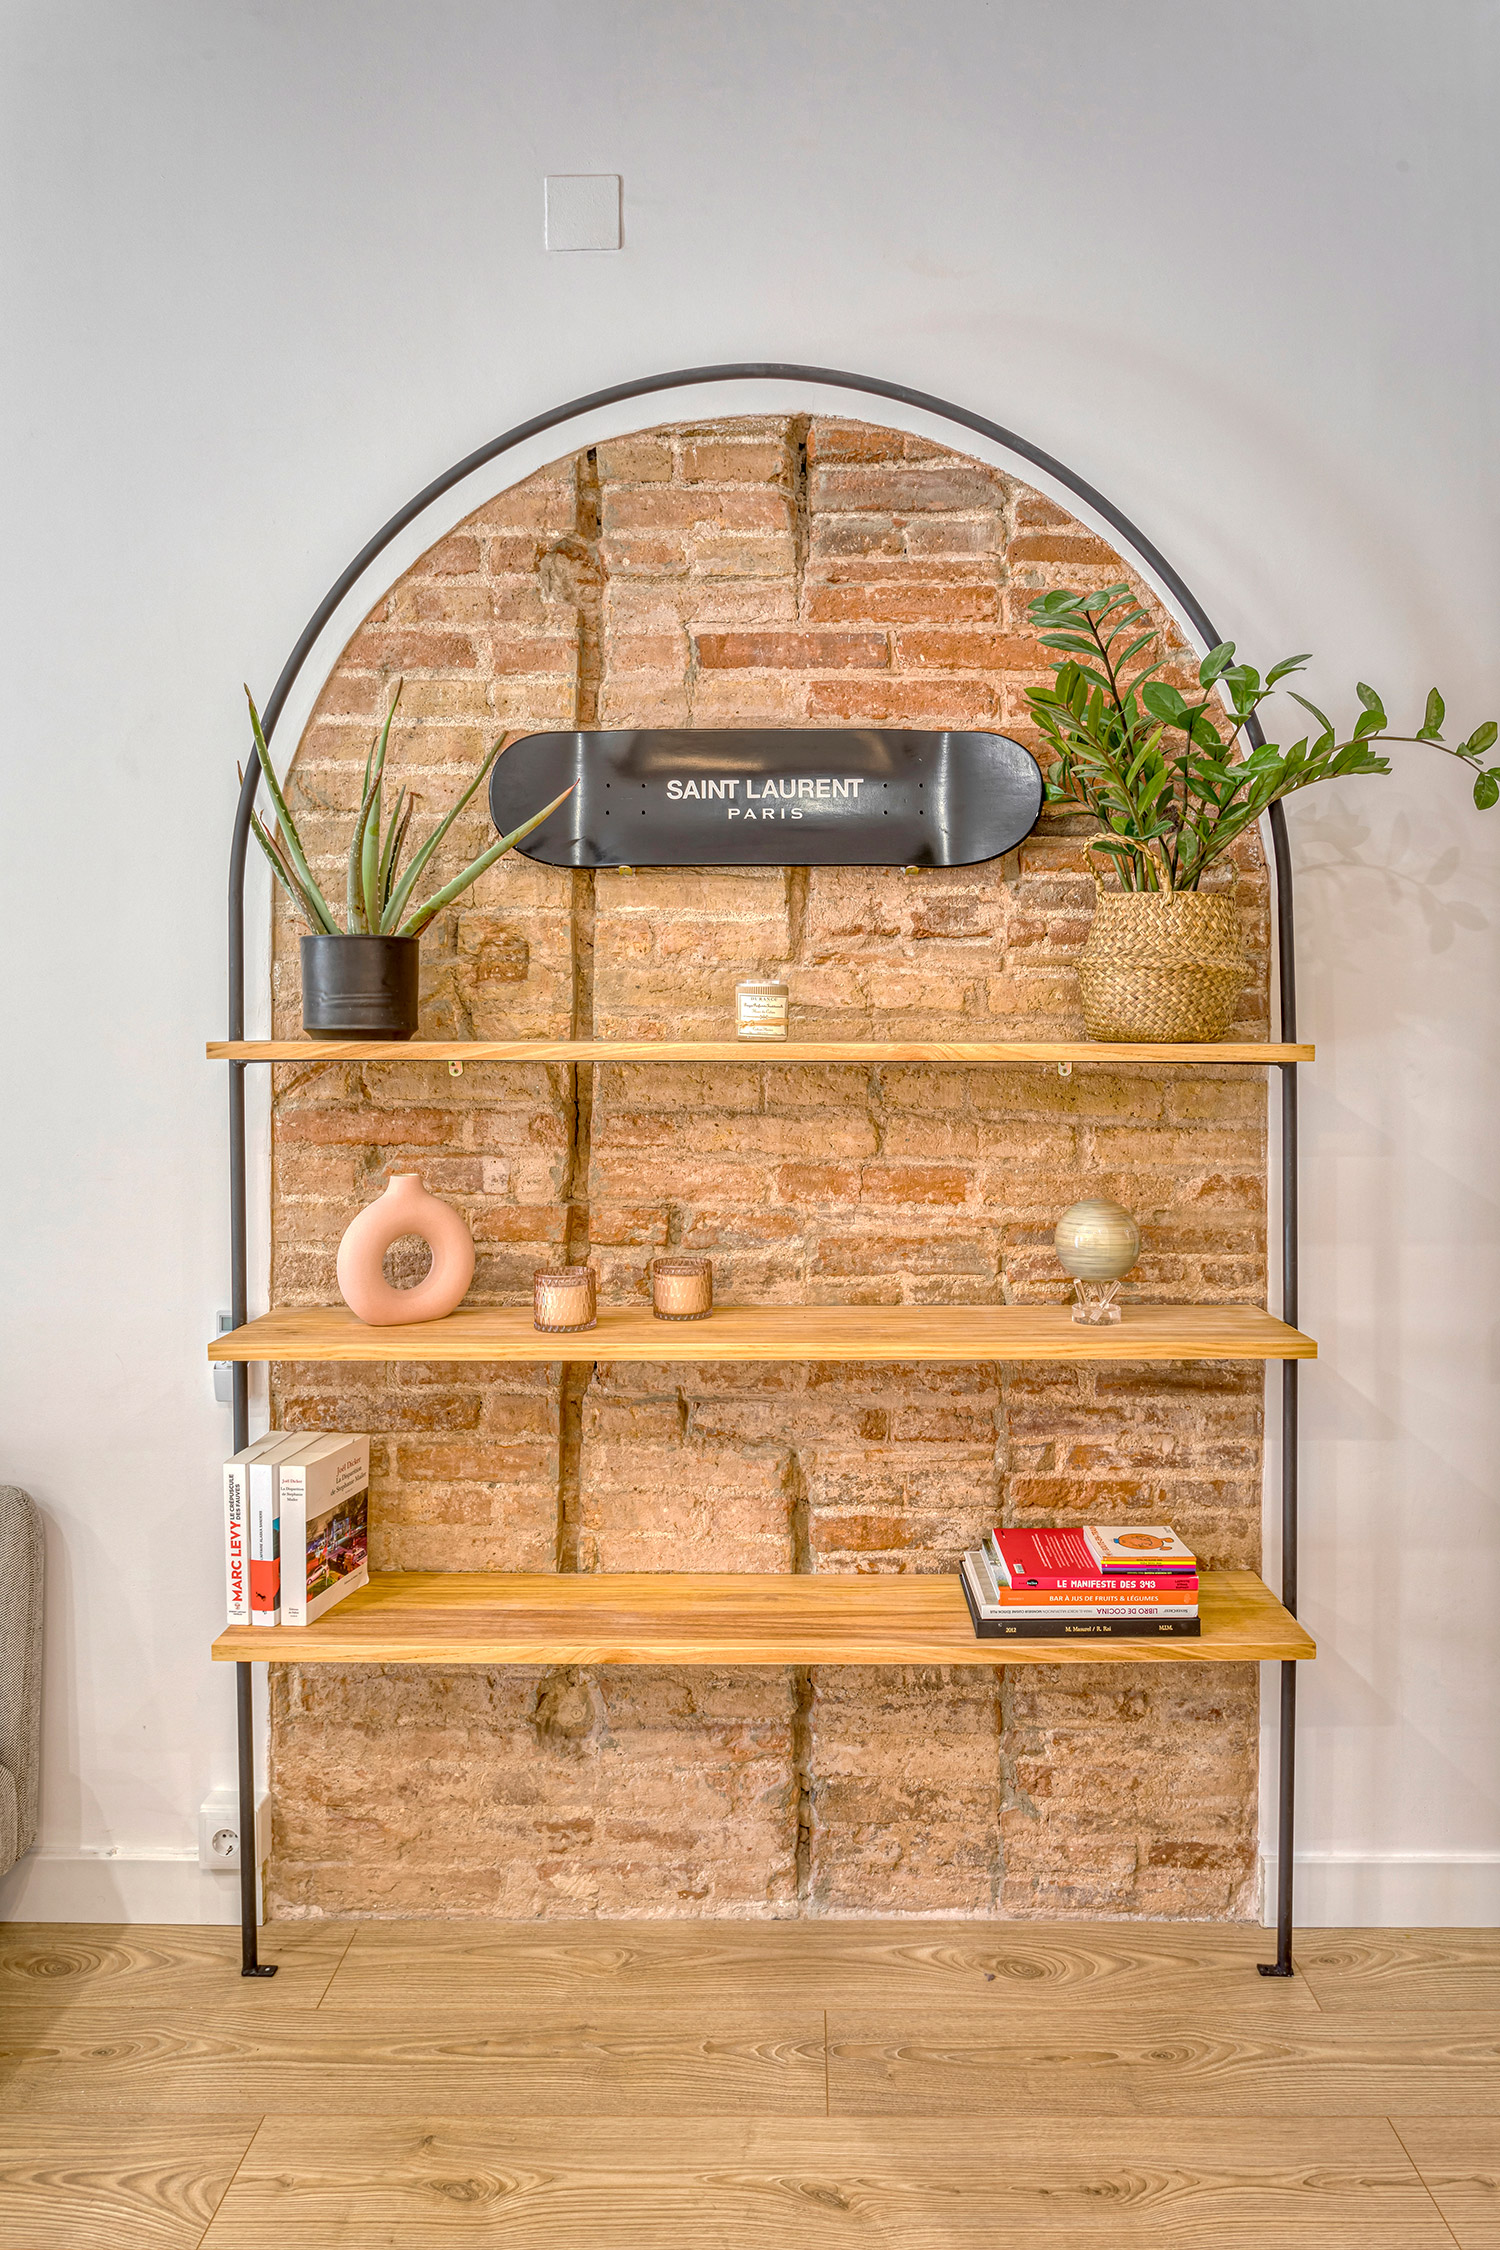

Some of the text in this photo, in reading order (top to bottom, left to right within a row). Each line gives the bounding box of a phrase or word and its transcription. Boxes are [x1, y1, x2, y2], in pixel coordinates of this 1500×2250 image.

[666, 778, 864, 800] SAINT LAURENT
[728, 808, 803, 820] PARIS
[230, 1521, 242, 1557] LEVY
[231, 1560, 243, 1601] MARC
[1057, 1580, 1156, 1589] LE MANIFESTE DES 343
